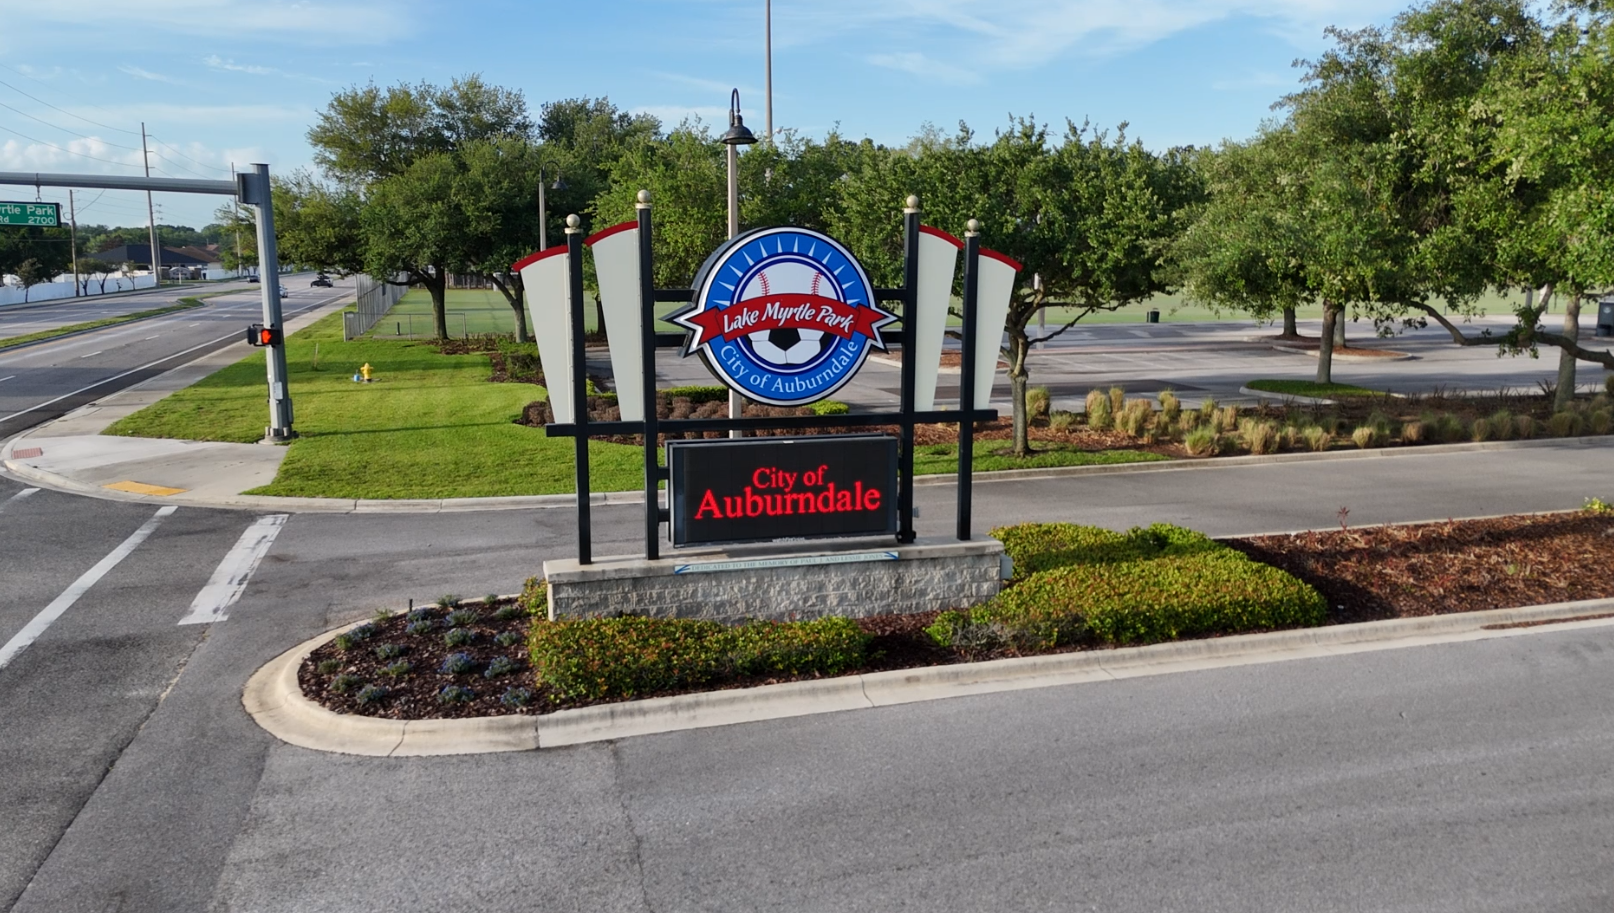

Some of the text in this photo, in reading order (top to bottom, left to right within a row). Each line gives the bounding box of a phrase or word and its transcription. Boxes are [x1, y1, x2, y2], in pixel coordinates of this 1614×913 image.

[0, 204, 54, 215] rtle Park
[27, 216, 54, 224] 2700
[724, 301, 854, 333] Lake Myrtle Park
[720, 341, 858, 393] City of Auburndale
[752, 464, 829, 492] City of
[694, 480, 881, 519] Auburndale
[743, 561, 756, 569] THE
